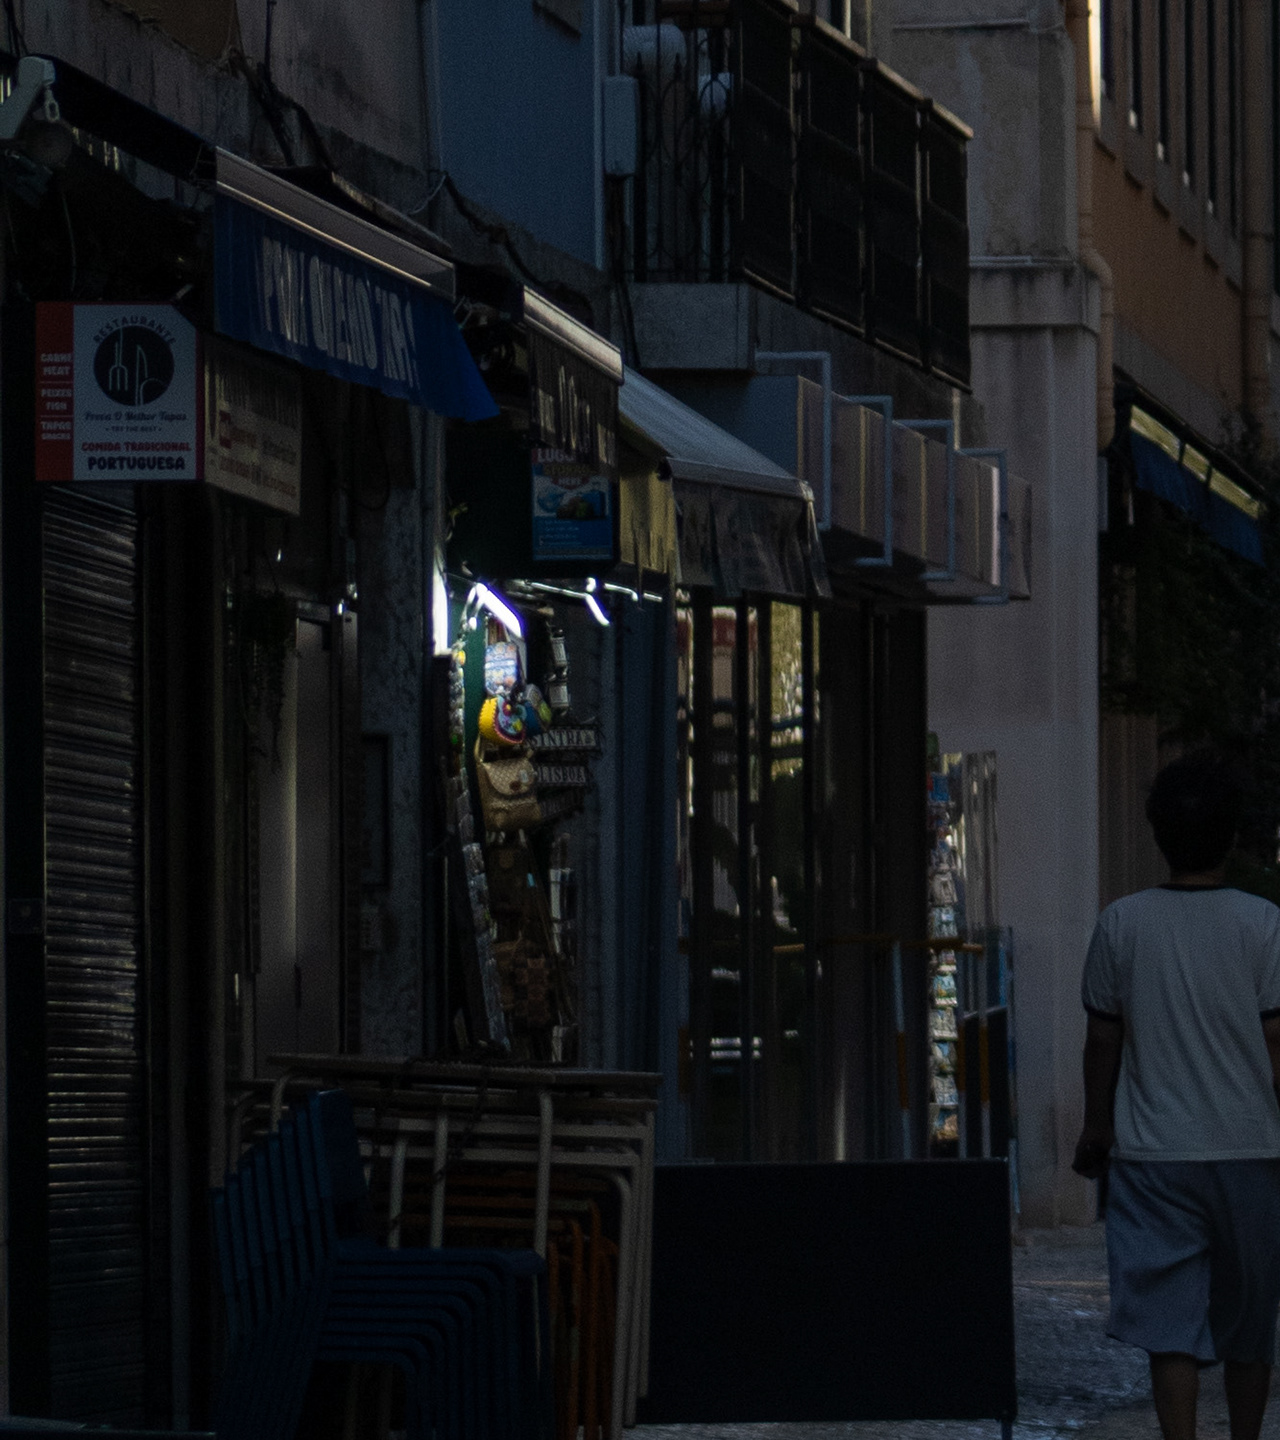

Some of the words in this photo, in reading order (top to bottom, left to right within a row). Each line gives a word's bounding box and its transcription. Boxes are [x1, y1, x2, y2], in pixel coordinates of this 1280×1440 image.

[93, 316, 176, 344] RESTAURANTE
[82, 442, 121, 451] COMIDA
[124, 441, 191, 451] TRADICIONAL
[88, 456, 185, 470] PORTUGUESA
